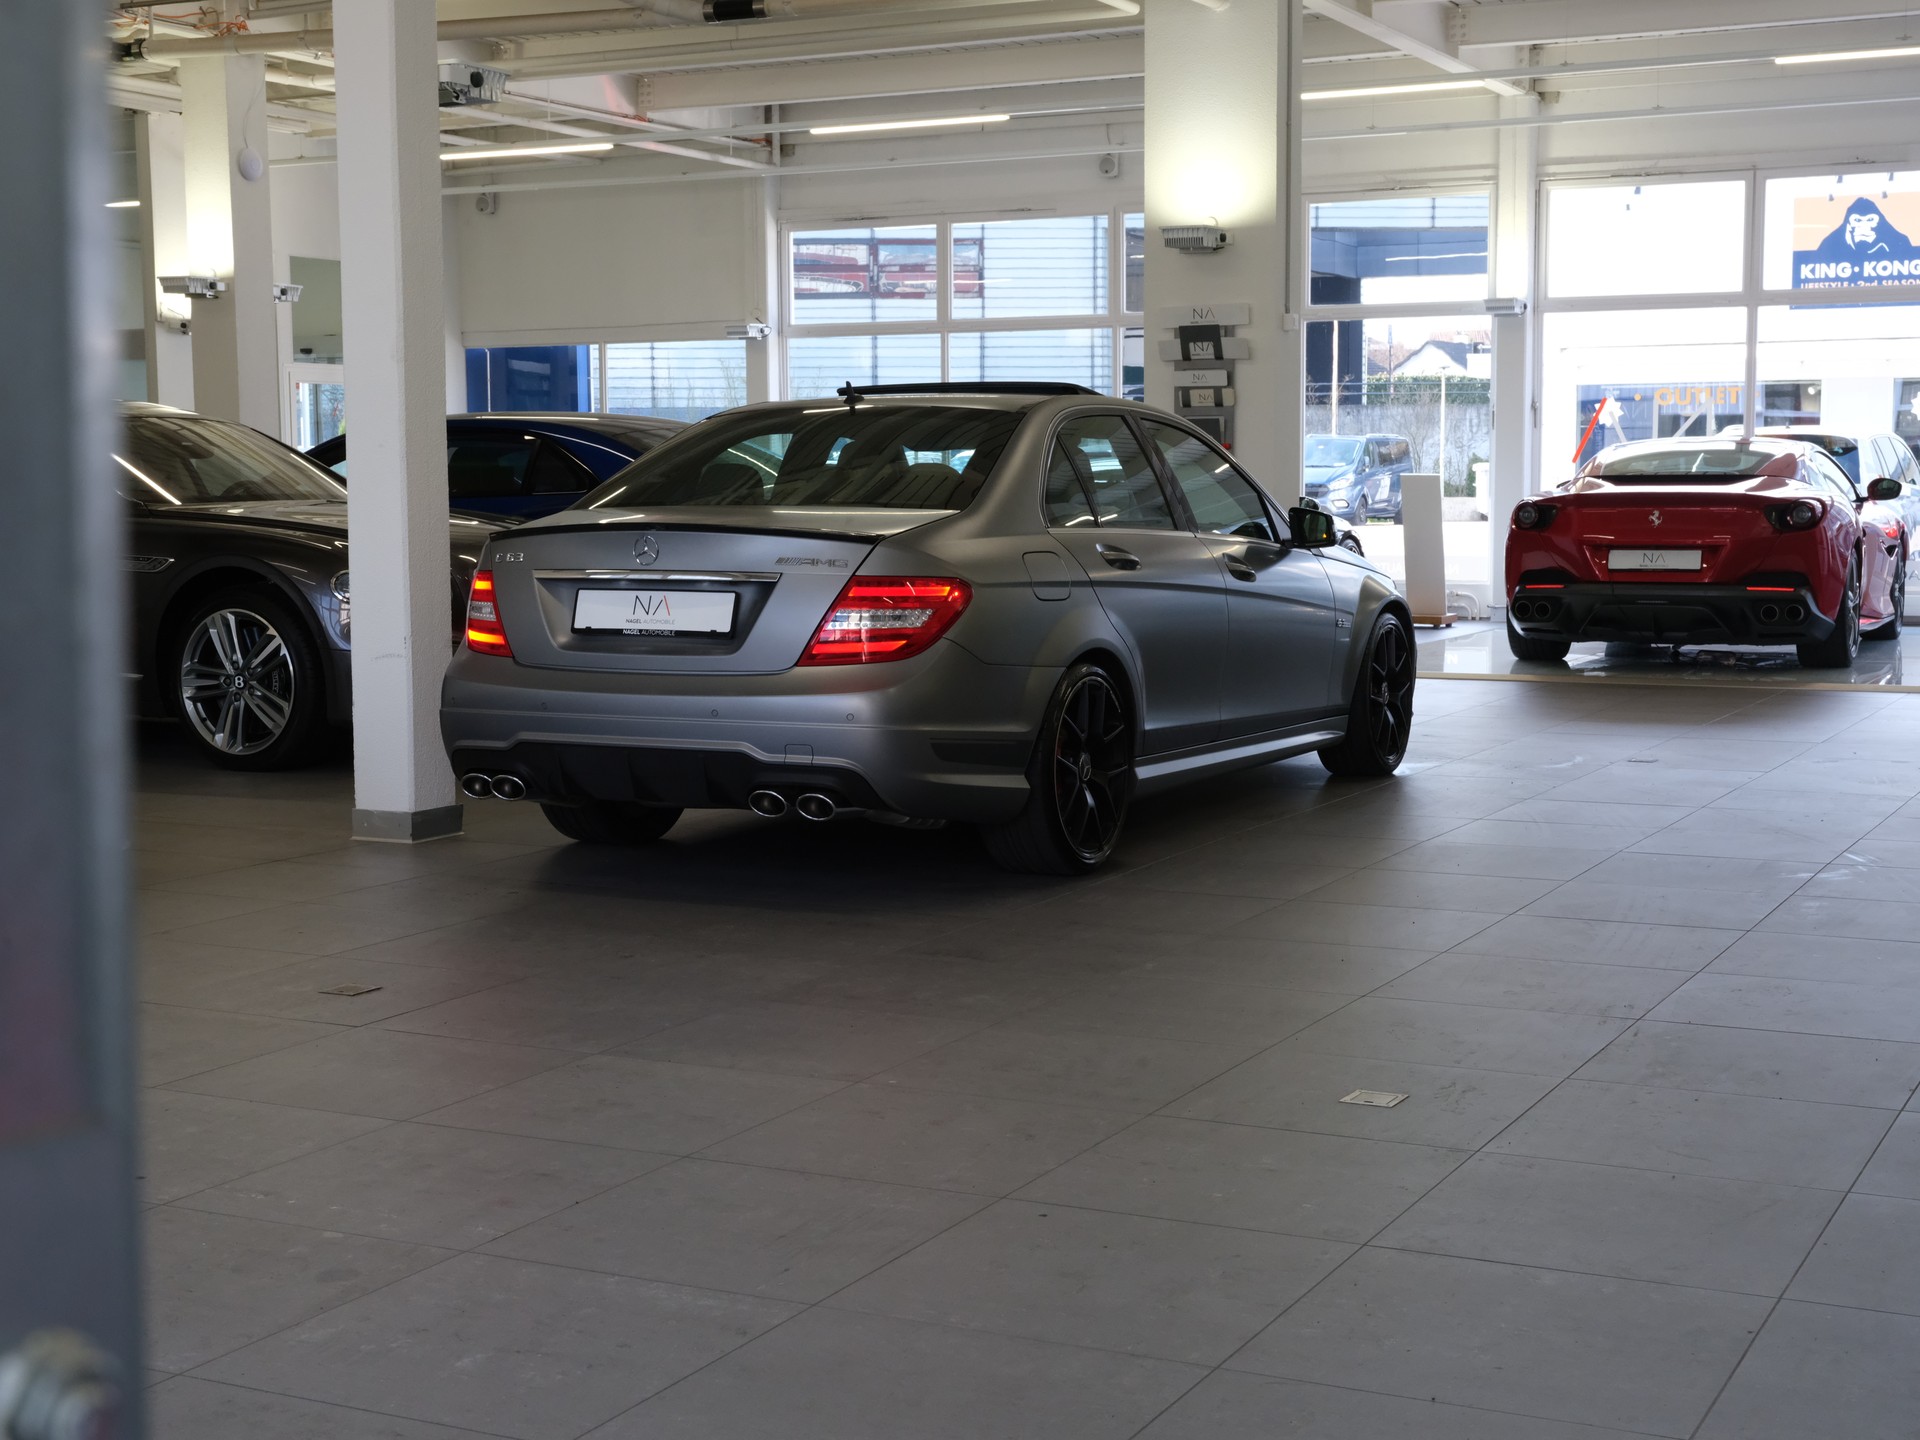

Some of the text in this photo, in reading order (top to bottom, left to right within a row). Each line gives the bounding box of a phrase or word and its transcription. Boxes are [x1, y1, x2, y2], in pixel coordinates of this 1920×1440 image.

[1800, 262, 1852, 279] KING
[1655, 387, 1742, 406] OUTLET
[506, 552, 524, 562] 63
